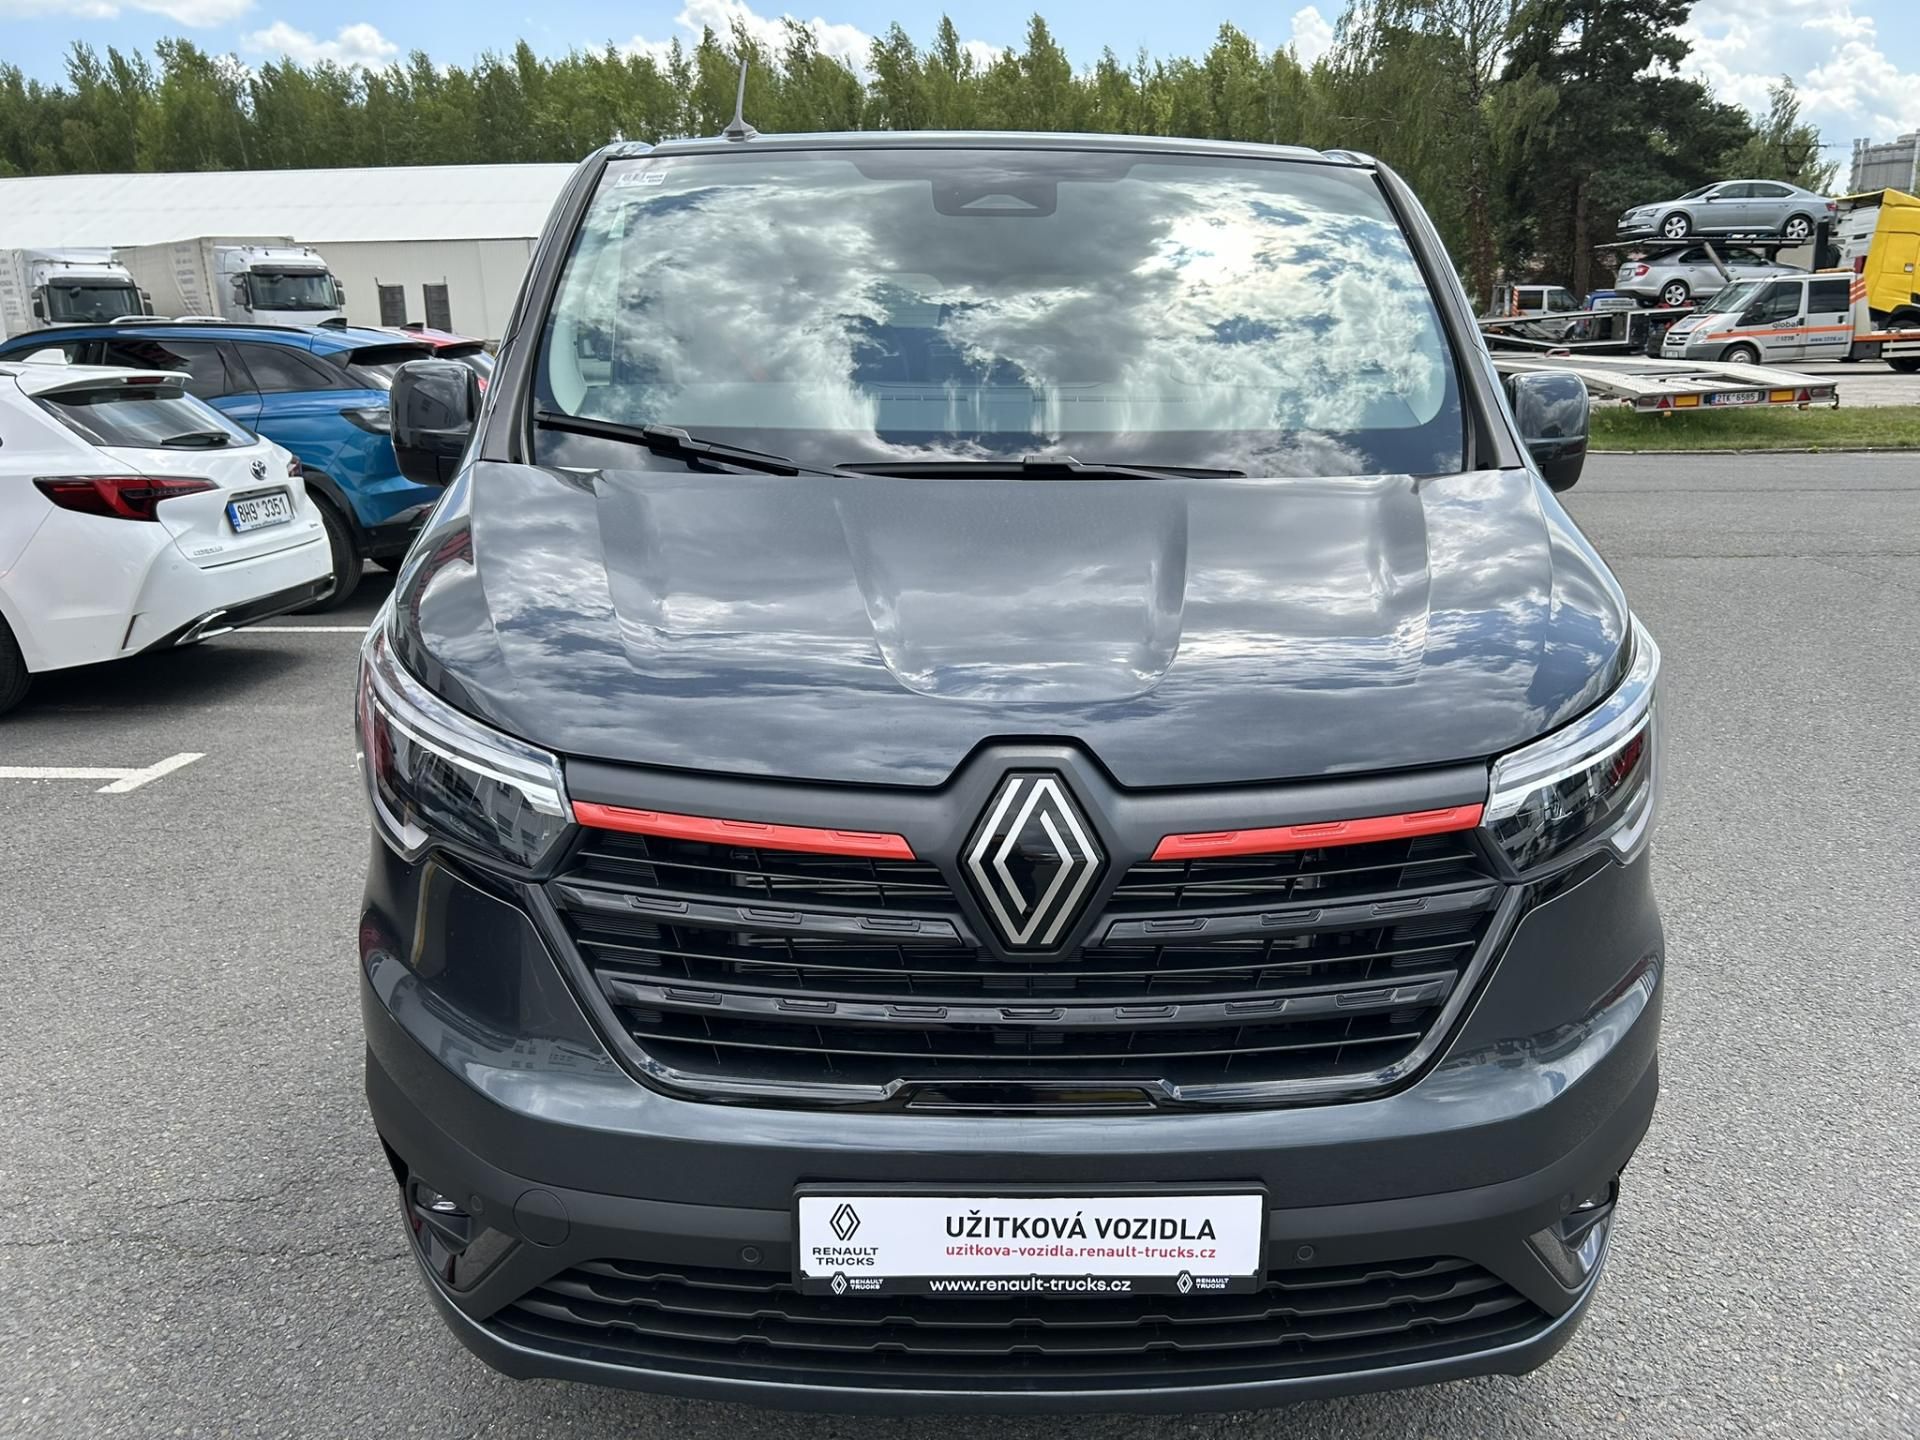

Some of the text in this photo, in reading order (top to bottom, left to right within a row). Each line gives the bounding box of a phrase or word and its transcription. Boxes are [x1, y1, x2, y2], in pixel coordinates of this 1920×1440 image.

[1717, 394, 1730, 403] 2TK
[237, 496, 287, 523] 8H9 3351
[946, 1209, 1217, 1240] UŽITKOVÁ VOZIDLA
[812, 1247, 879, 1256] RENAULT
[946, 1244, 1216, 1258] uzitkova-vozidla.renault-trucks.cz
[815, 1257, 875, 1266] TRUCKS
[929, 1276, 1131, 1292] www.renault-trucks.cz
